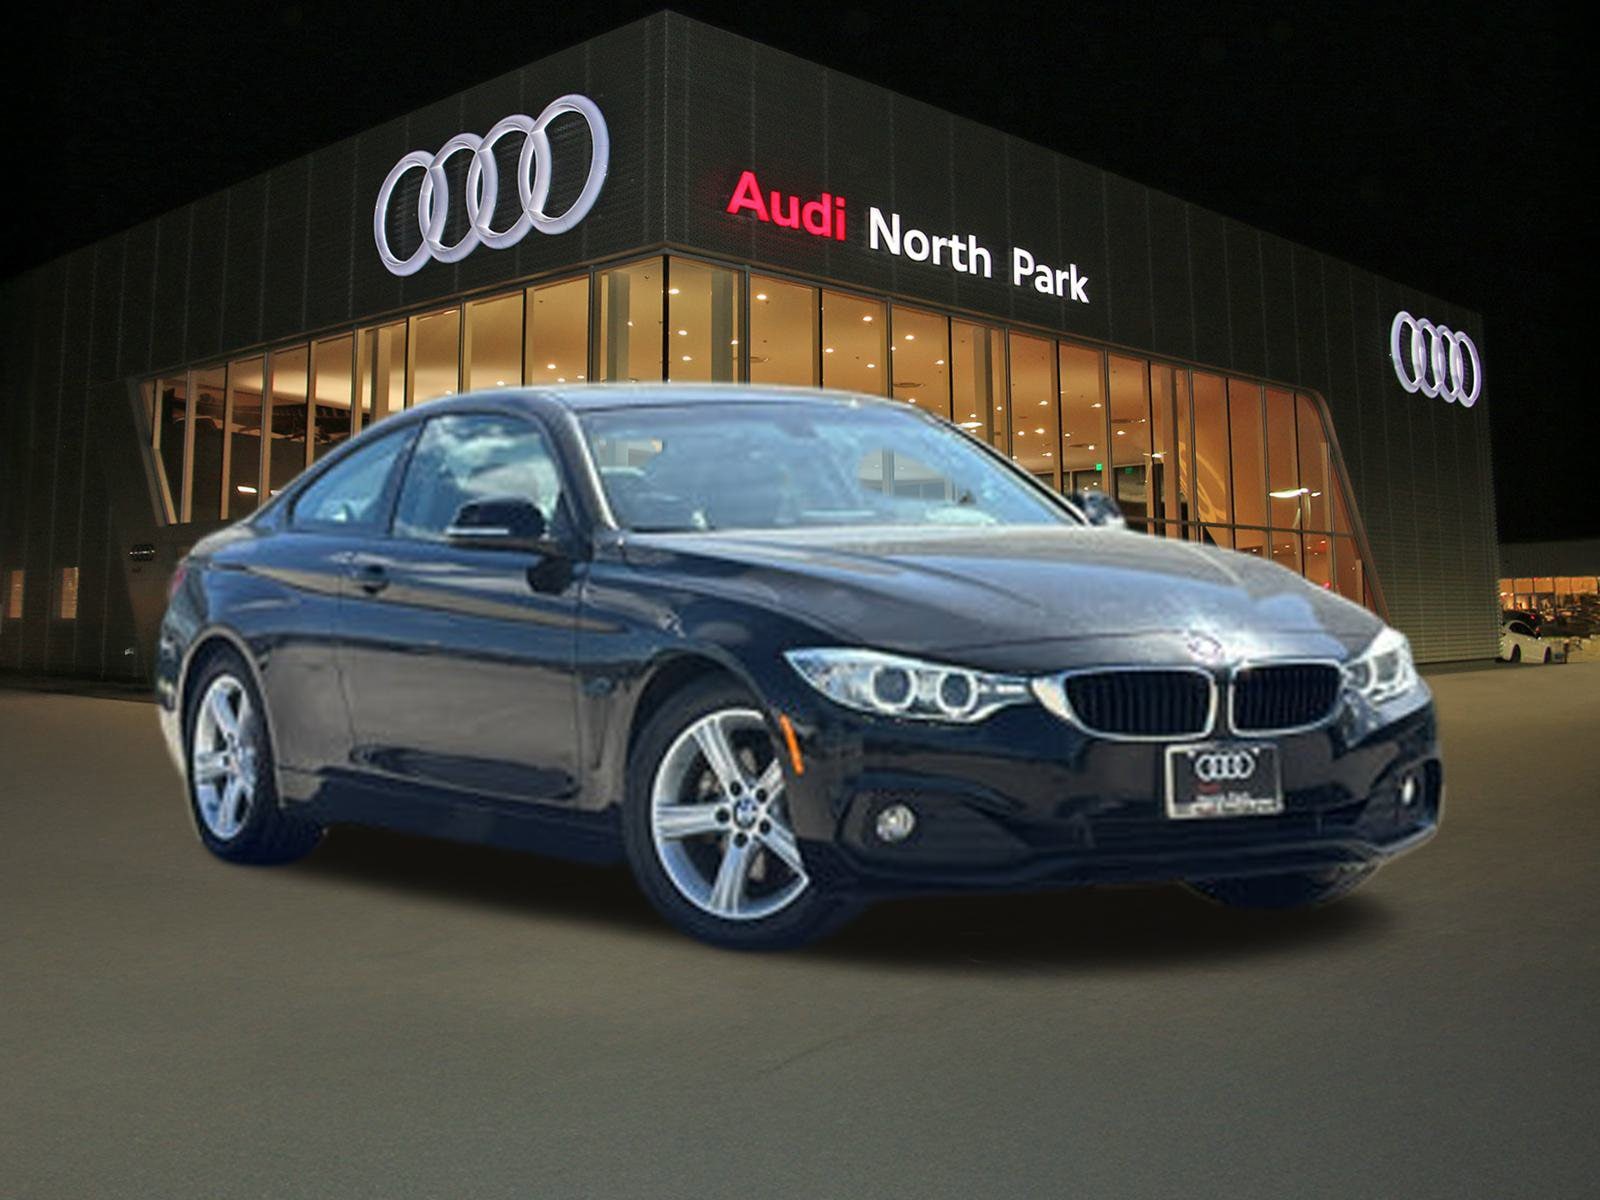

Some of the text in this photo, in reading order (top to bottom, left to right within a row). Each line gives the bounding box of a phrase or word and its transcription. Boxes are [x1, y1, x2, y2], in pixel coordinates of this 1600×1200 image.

[727, 171, 1090, 304] Audi North Park
